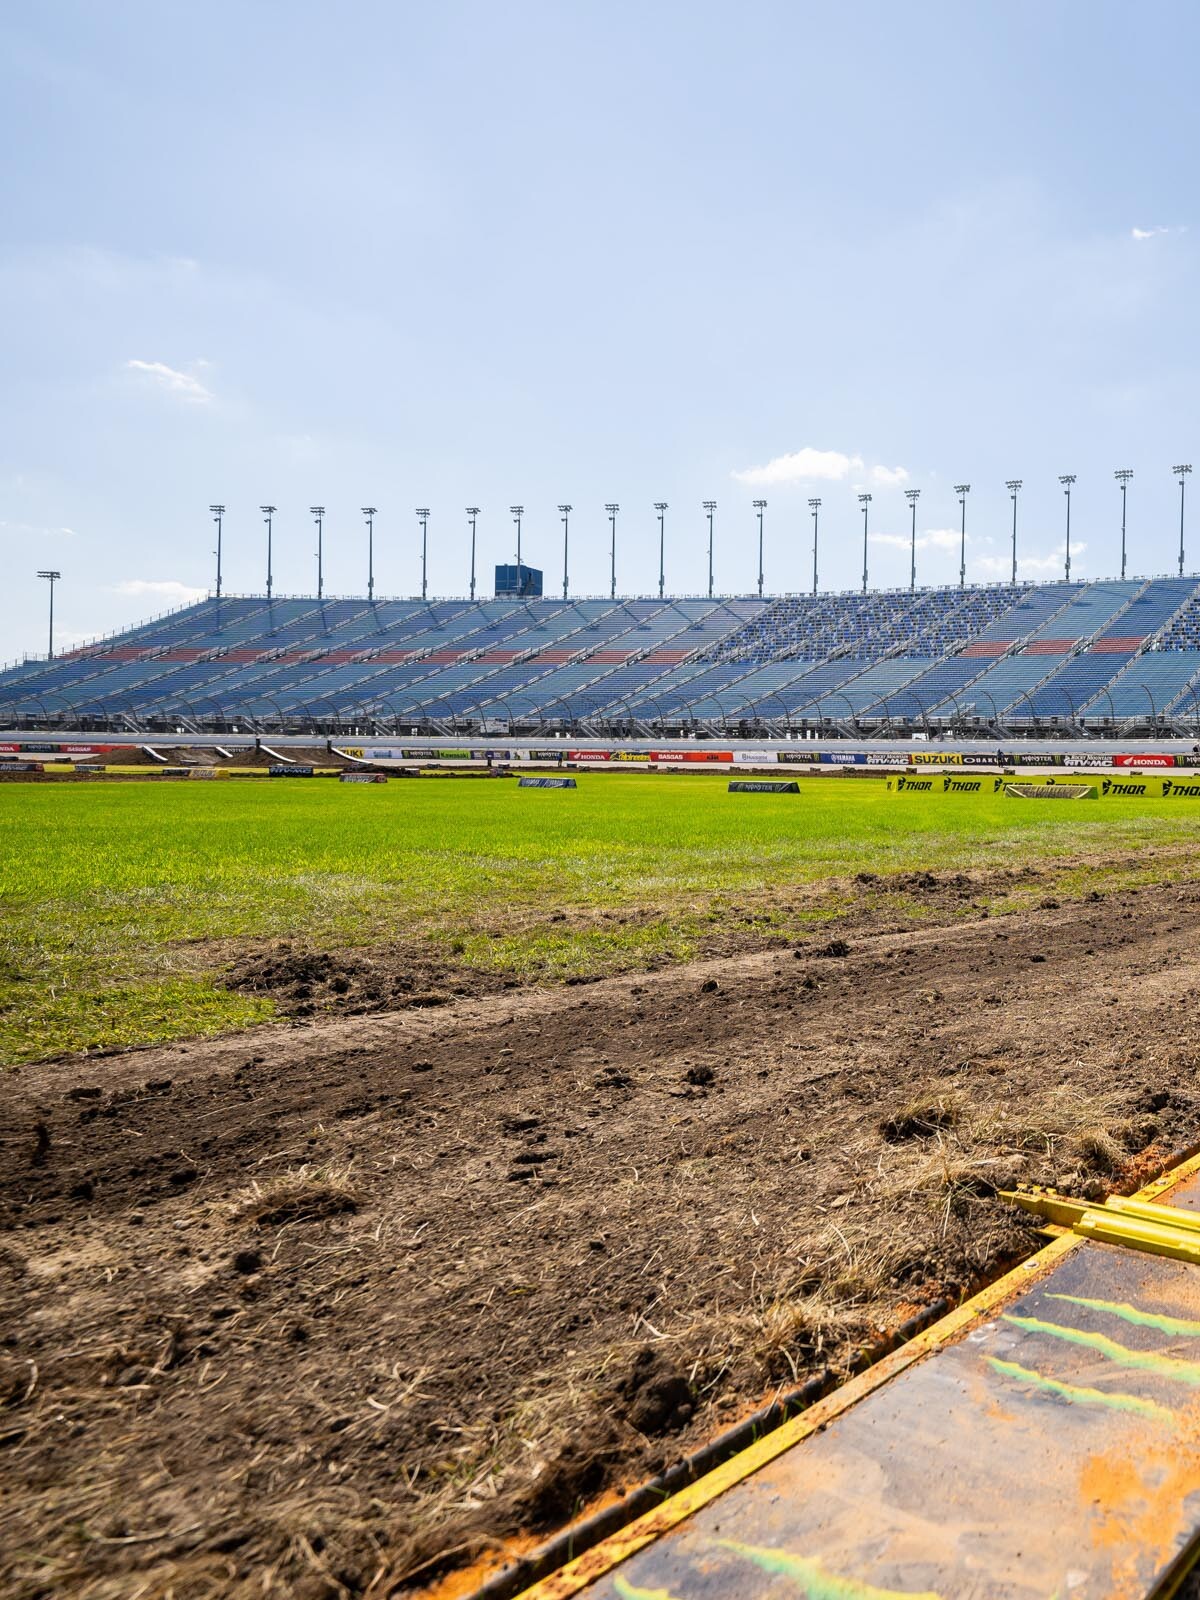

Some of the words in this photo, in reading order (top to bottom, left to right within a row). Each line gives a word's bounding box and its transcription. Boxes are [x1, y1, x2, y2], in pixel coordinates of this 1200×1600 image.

[914, 755, 960, 764] SUZUKI
[905, 781, 933, 791] THOR
[951, 782, 982, 791] THOR
[1112, 784, 1146, 795] THOR
